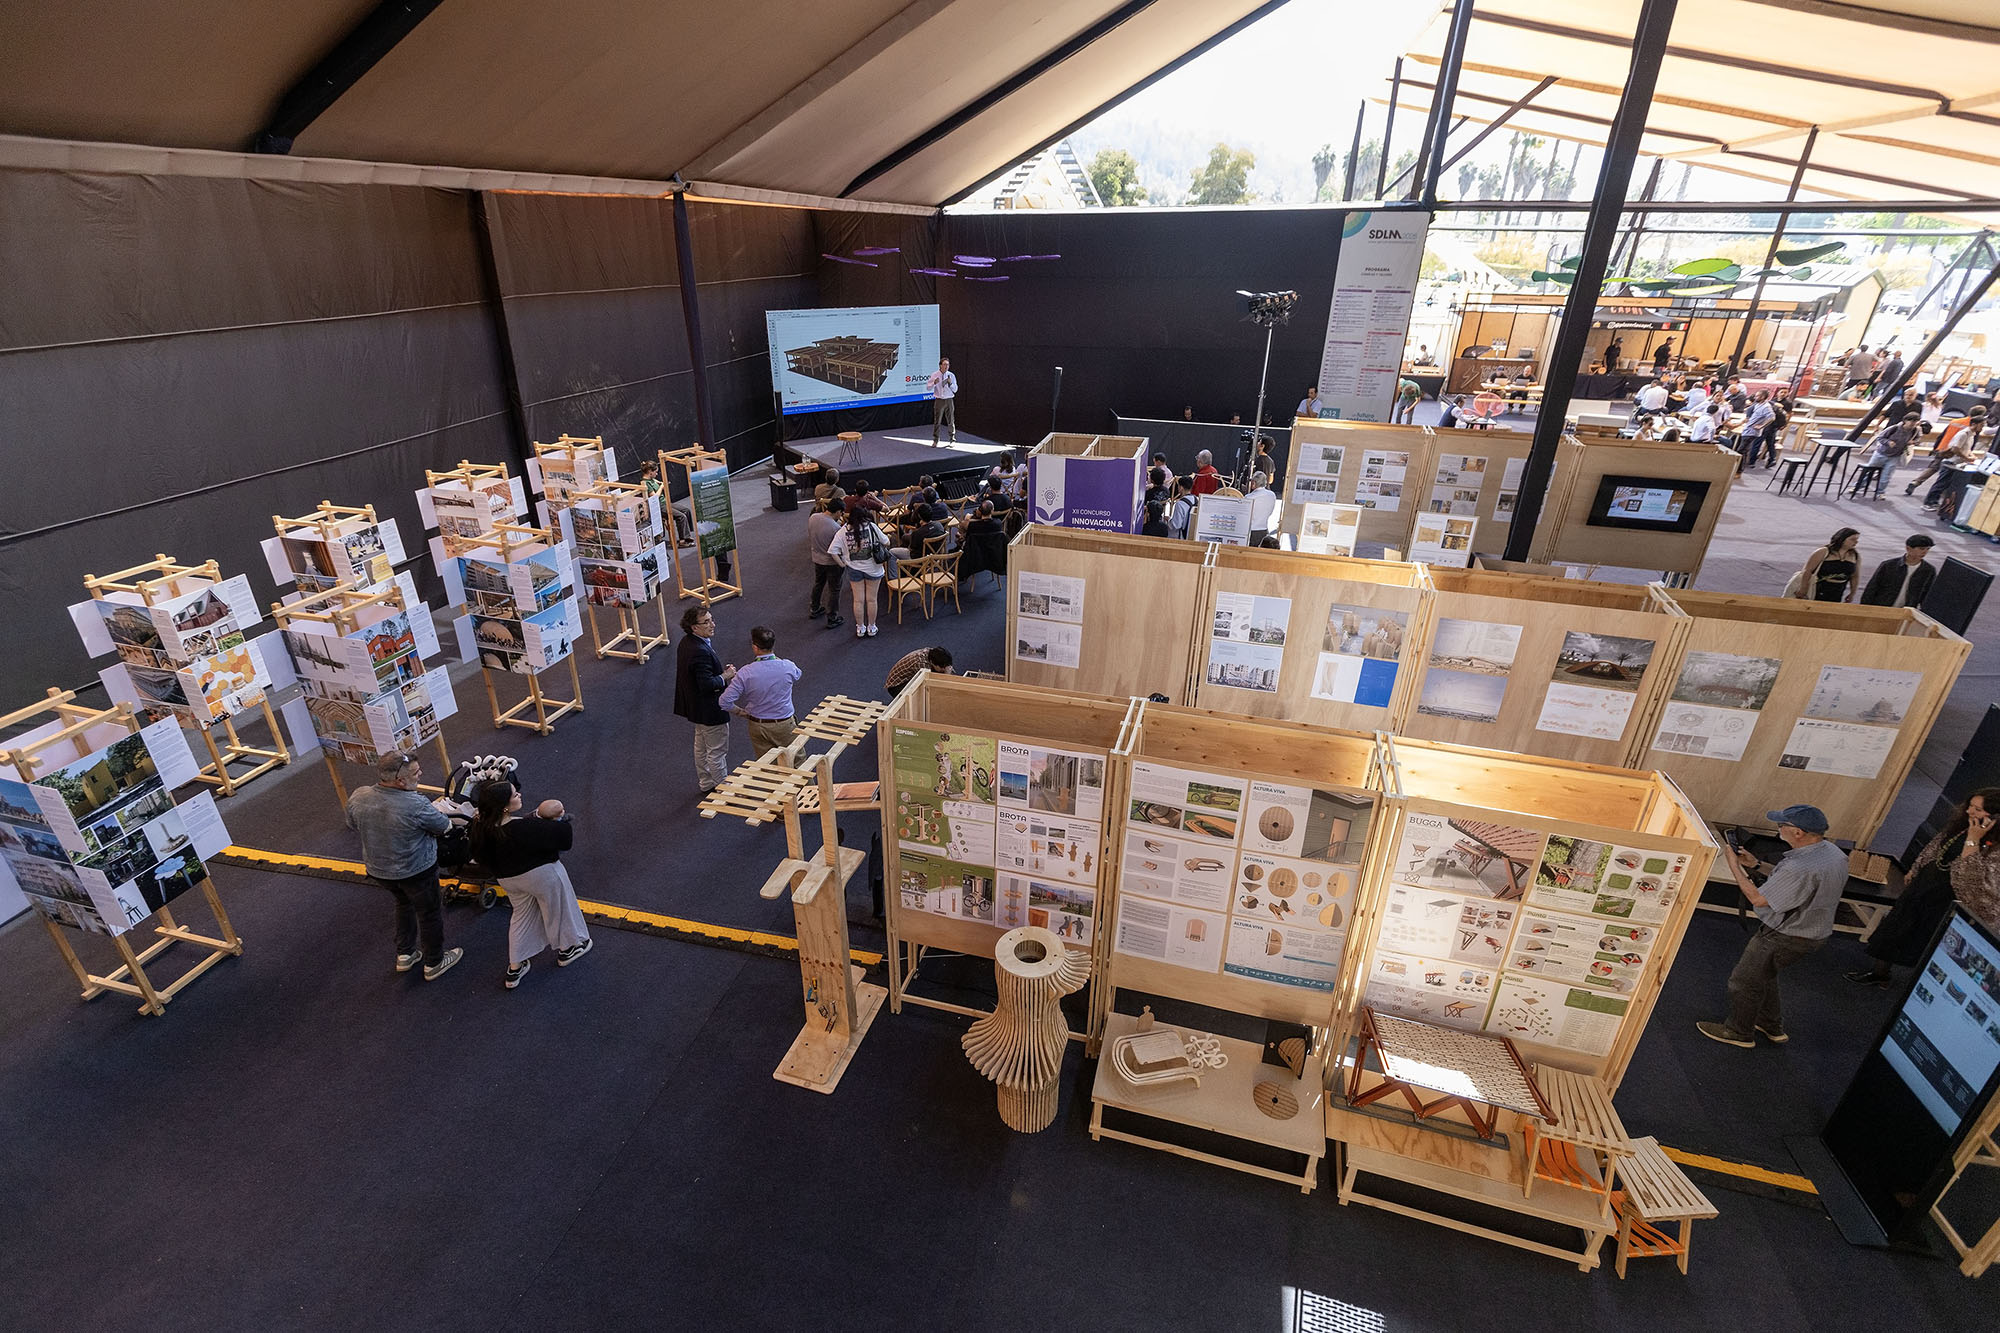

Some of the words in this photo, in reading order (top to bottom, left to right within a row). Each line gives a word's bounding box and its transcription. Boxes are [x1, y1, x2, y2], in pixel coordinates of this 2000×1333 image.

[1080, 509, 1111, 517] CONCURSO
[1072, 517, 1116, 527] INNOVACIÓN
[1001, 745, 1029, 756] BROTA
[1000, 811, 1027, 822] BROTA
[1409, 816, 1443, 828] BUGGA
